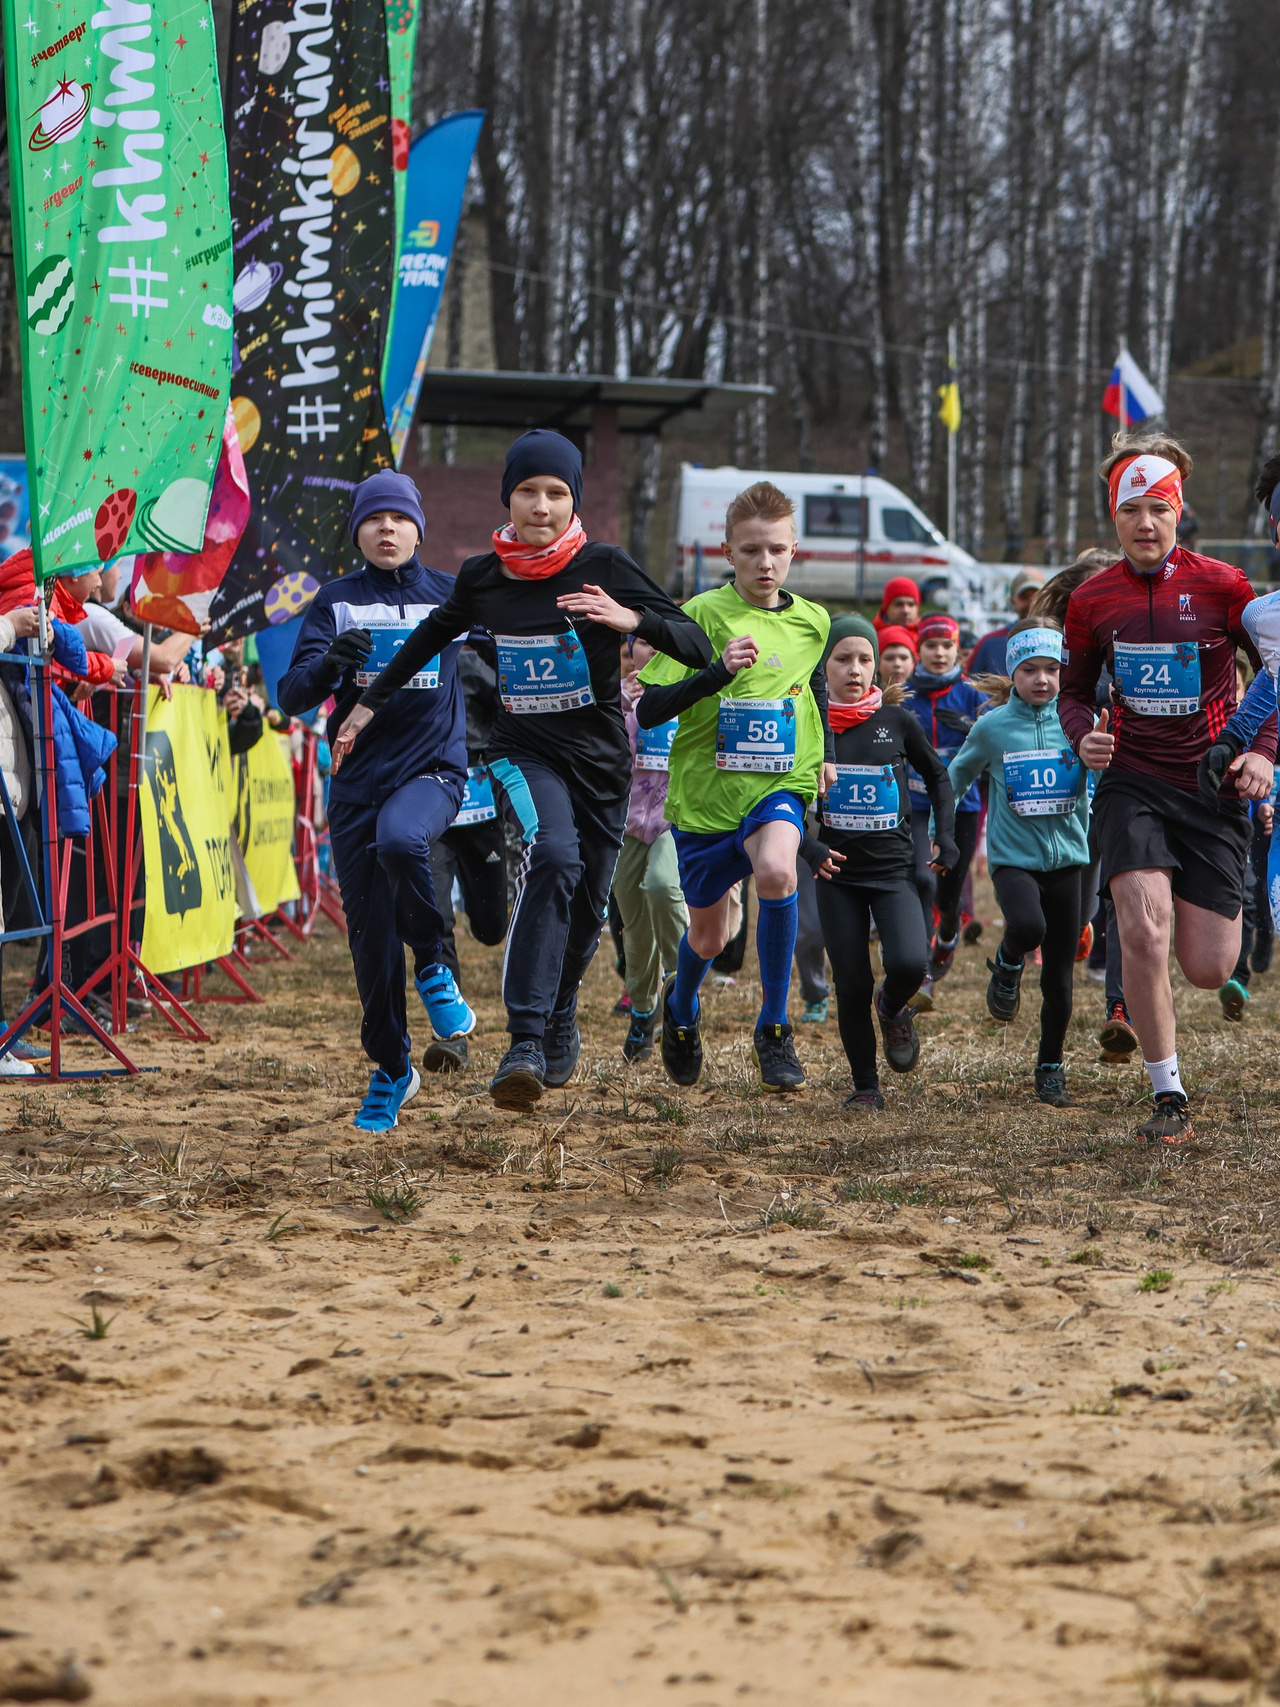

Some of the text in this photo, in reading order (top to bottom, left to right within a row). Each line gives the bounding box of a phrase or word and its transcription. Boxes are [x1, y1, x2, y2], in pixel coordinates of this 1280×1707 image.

[31, 21, 87, 69] #четверг
[129, 360, 220, 400] #северноесияние
[523, 658, 558, 681] 12
[1140, 664, 1172, 685] 24
[540, 680, 575, 690] Александр
[747, 720, 778, 742] 58
[1029, 768, 1057, 788] 10
[849, 784, 877, 803] 13
[1016, 789, 1045, 797] Карпухина
[839, 803, 884, 812] Серякова Лидия
